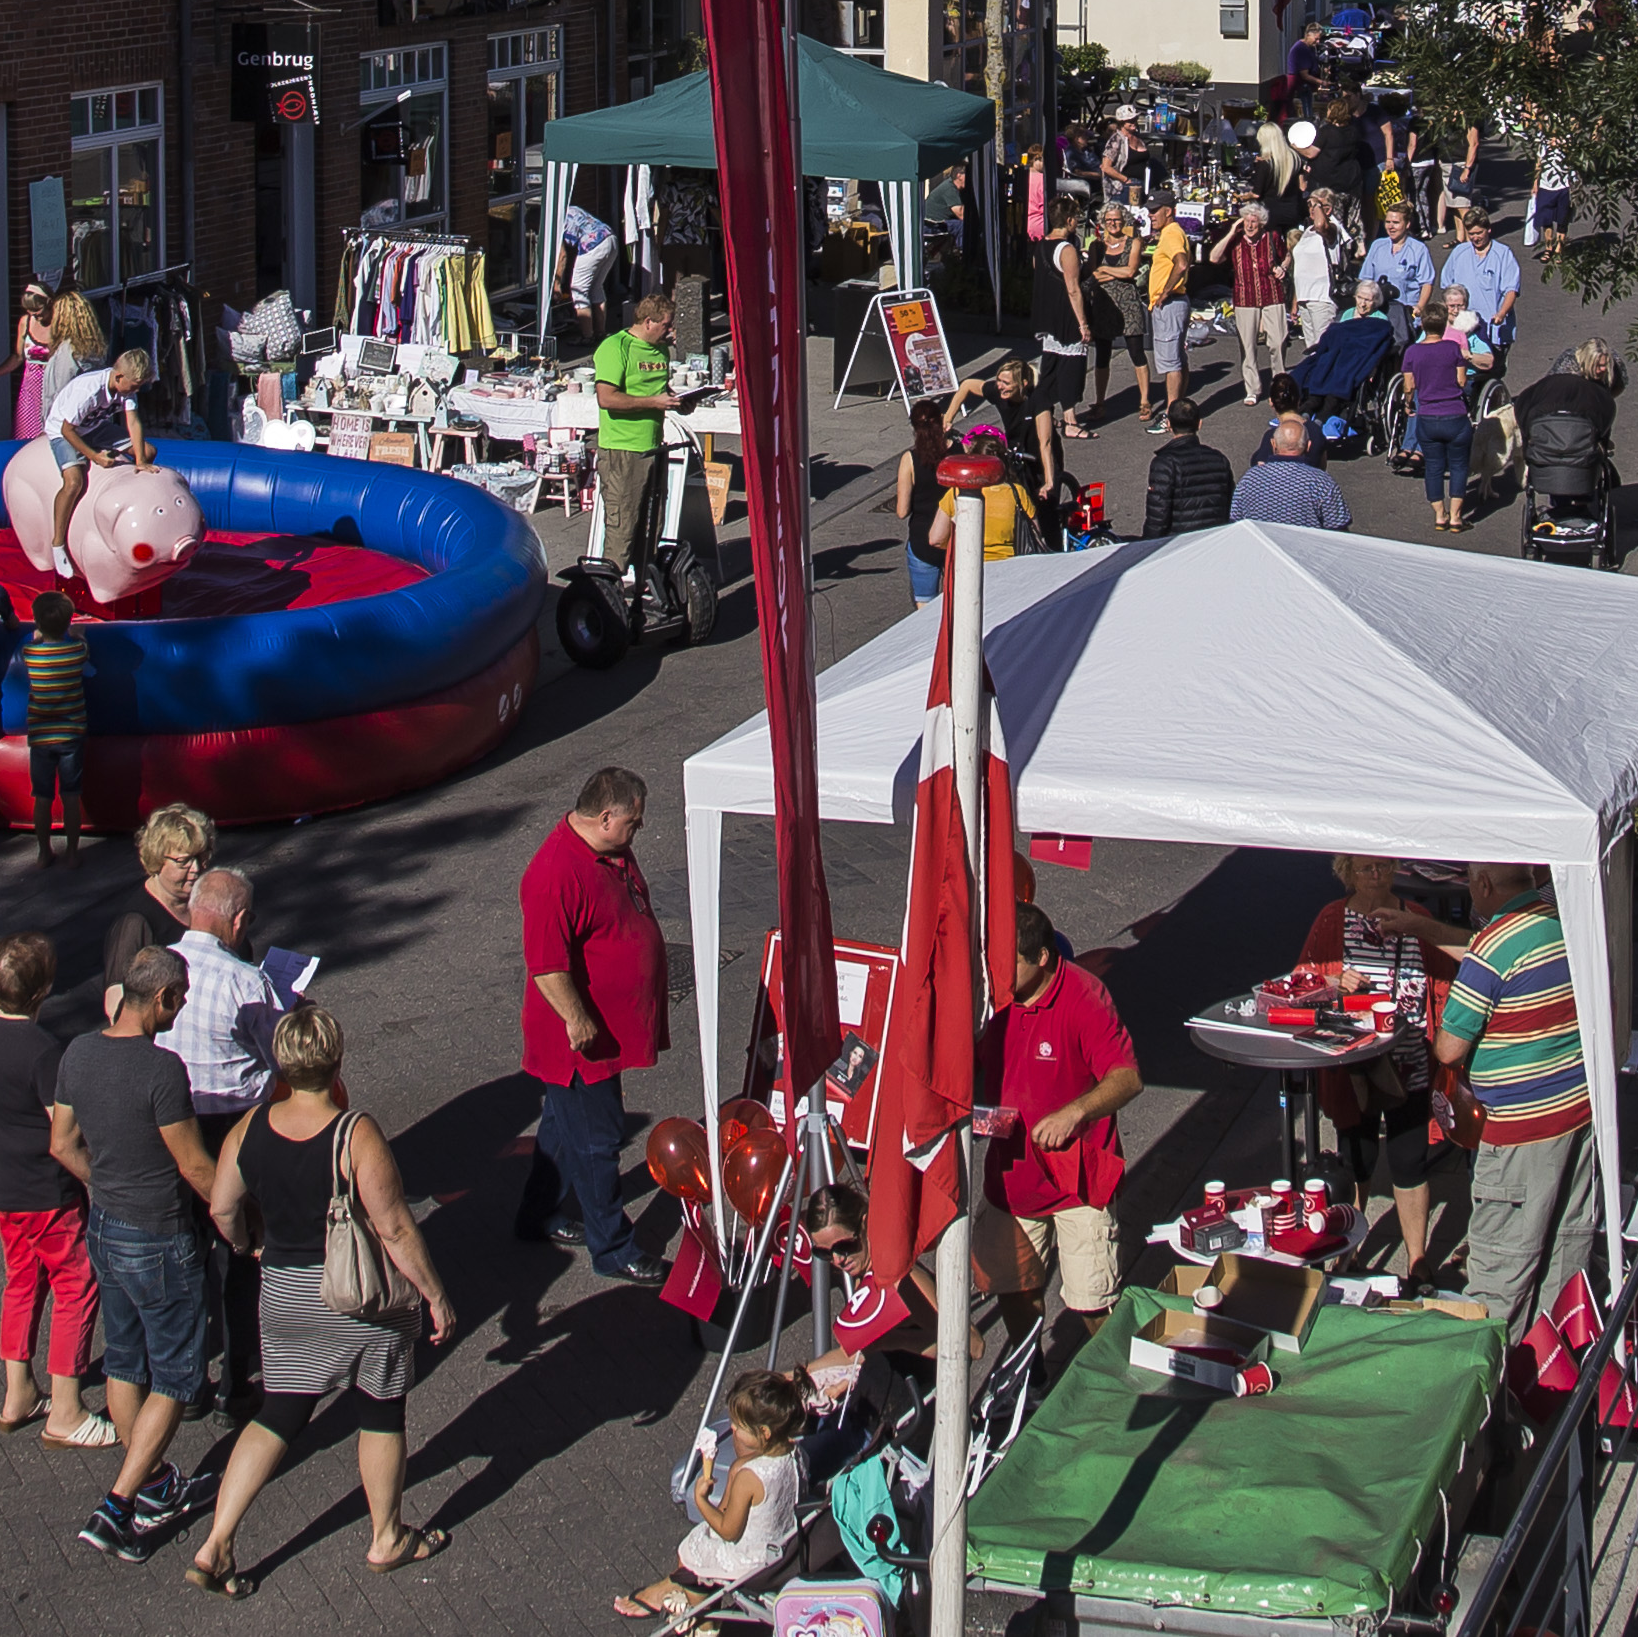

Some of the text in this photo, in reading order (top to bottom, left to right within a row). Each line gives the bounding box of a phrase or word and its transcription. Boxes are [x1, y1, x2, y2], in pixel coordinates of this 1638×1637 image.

[237, 51, 314, 70] Genbrug
[332, 416, 371, 432] HOME IS
[330, 432, 367, 448] WHEREVER
